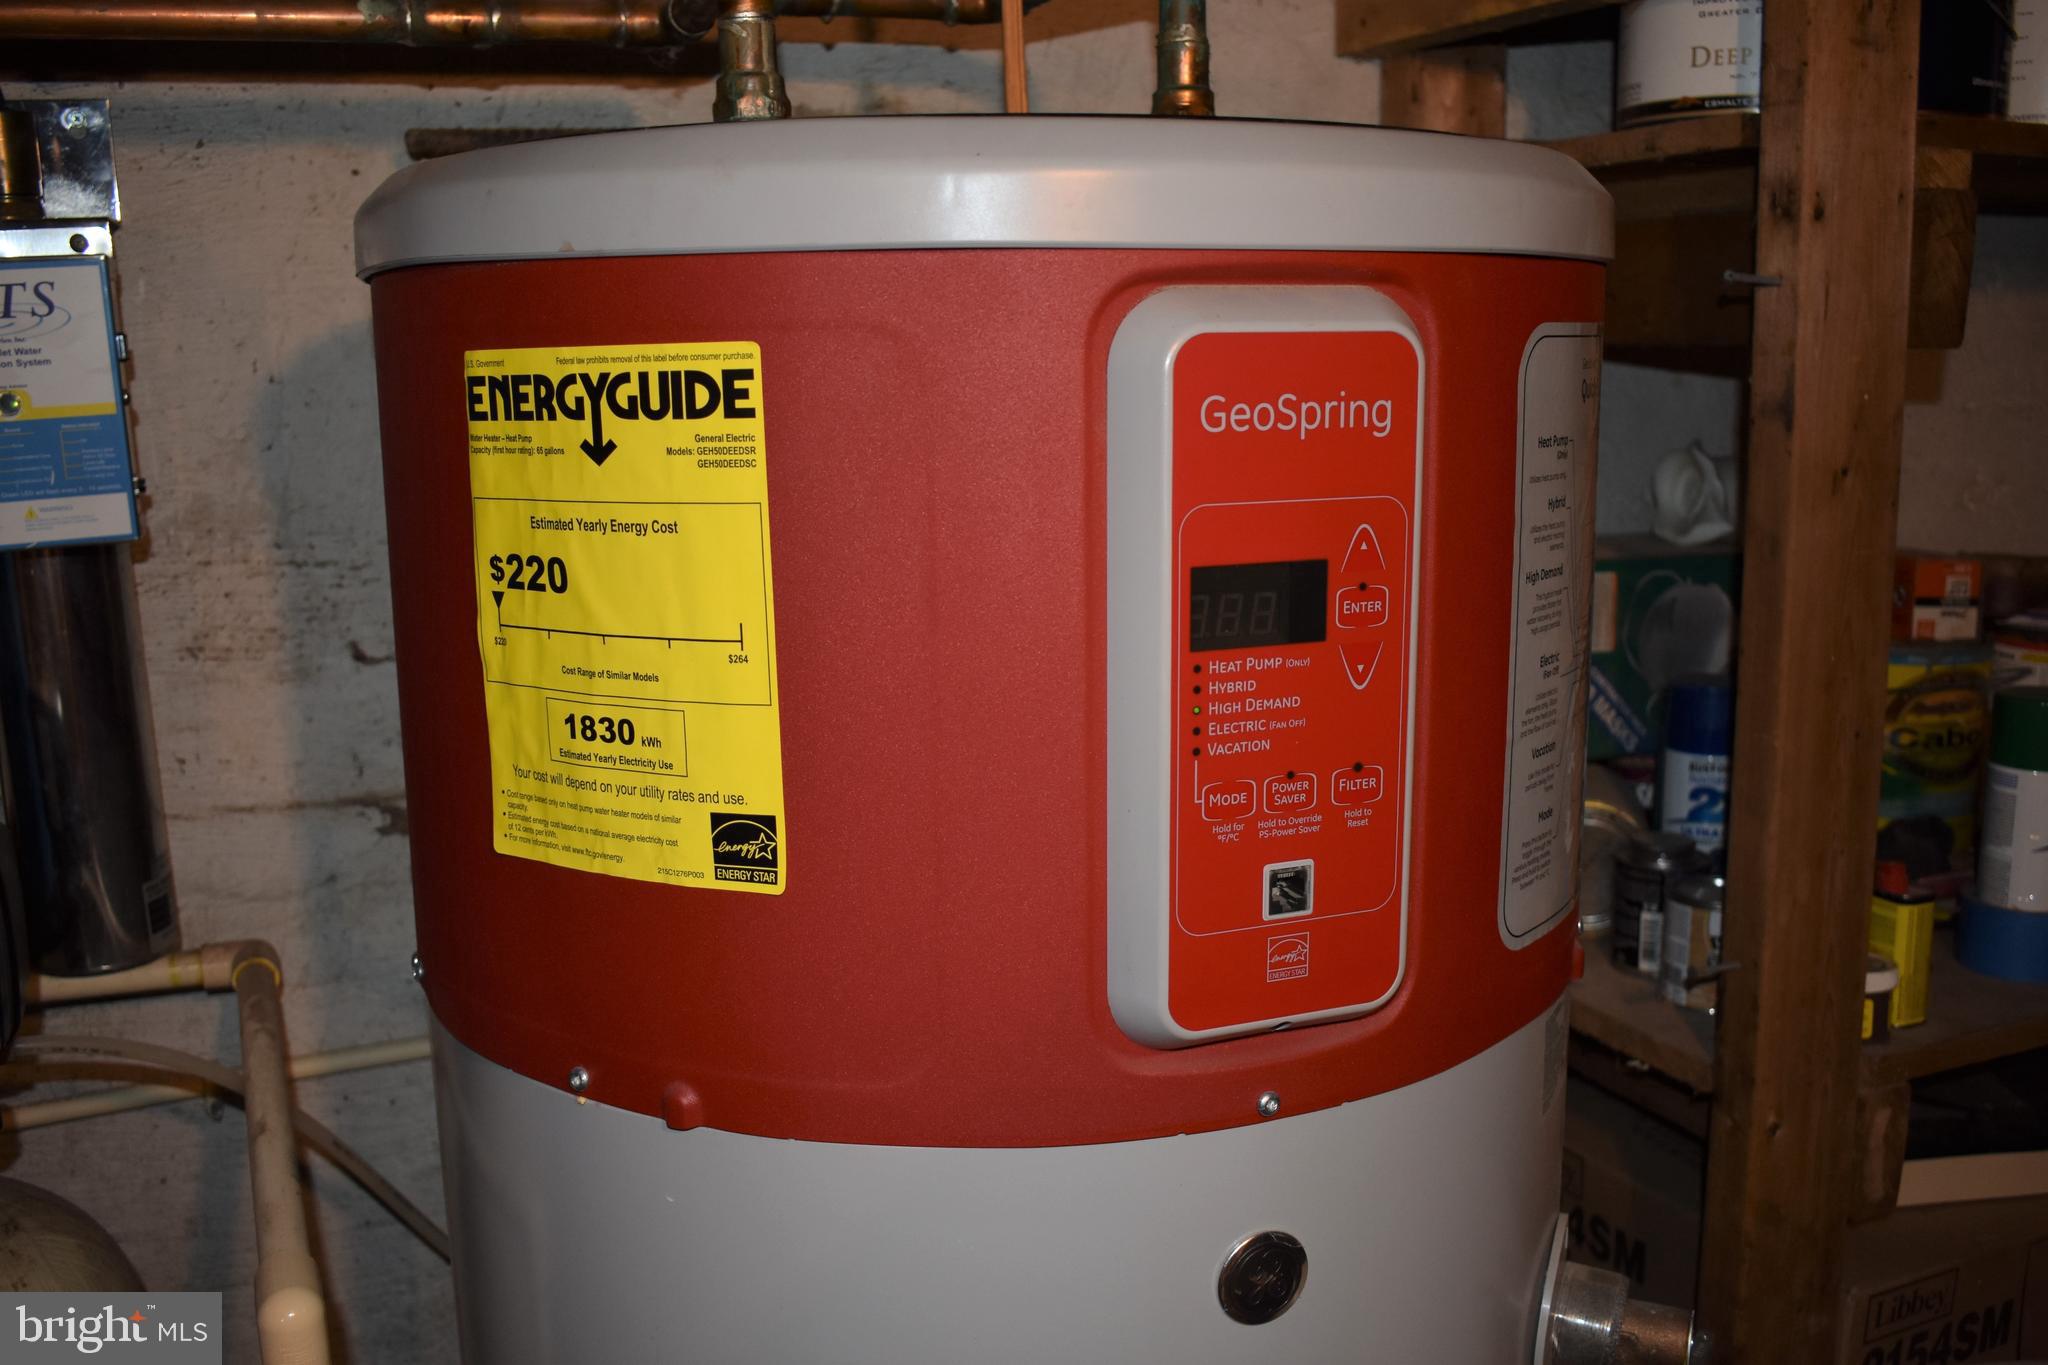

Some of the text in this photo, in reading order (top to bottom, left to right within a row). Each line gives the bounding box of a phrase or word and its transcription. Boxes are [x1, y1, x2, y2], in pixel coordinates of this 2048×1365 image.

[1690, 46, 1753, 68] DEEP
[15, 348, 42, 356] Water
[556, 357, 575, 366] Federal
[575, 357, 585, 366] law
[586, 356, 609, 368] prohibits
[610, 354, 633, 364] removal
[634, 353, 640, 363] of
[641, 353, 652, 363] this
[653, 353, 667, 362] label
[669, 352, 688, 362] before
[690, 353, 722, 361] consumer
[16, 359, 52, 370] System
[476, 359, 505, 370] Government
[467, 369, 757, 421] ENERGYGUIDE
[1200, 390, 1393, 440] GeoSpring
[484, 434, 501, 442] Heater
[505, 434, 517, 442] Heat
[518, 434, 533, 443] Pump
[695, 432, 756, 443] General Electric
[1537, 434, 1569, 449] Heat Pump
[471, 446, 491, 455] Capacity
[505, 446, 517, 455] hour
[544, 448, 565, 457] gallons
[666, 446, 756, 456] Models: GEH50DEEDSR
[697, 458, 757, 469] GEH50DEEDSC
[1547, 496, 1567, 512] Hybrid
[530, 516, 679, 537] Estimated Yearly Energy Cost
[489, 553, 568, 594] $220
[1525, 564, 1564, 584] High Demand
[1343, 600, 1382, 615] ENTER
[728, 653, 749, 665] $264
[1539, 651, 1560, 669] Electric
[561, 665, 659, 683] Cost Range of Similar Models
[564, 713, 662, 749] 1830 kWh
[559, 747, 674, 770] Estimated Yearly Electricity Use
[1531, 741, 1556, 760] Vacation
[512, 764, 748, 806] Your cost will depend on your utility rates and use.
[1271, 780, 1310, 794] POWER
[507, 788, 518, 799] Cost
[518, 791, 533, 802] range
[559, 800, 567, 808] on
[567, 800, 579, 811] heat
[579, 803, 593, 814] pump
[594, 806, 610, 816] water
[610, 807, 630, 818] heater
[630, 810, 653, 821] models
[653, 813, 661, 822] of
[661, 814, 682, 825] similar
[1274, 793, 1307, 806] SAVER
[1343, 807, 1373, 819] Hold to
[1537, 808, 1553, 824] Mode
[508, 811, 531, 823] Estimated
[532, 815, 549, 828] energy
[549, 818, 561, 829] cost
[561, 821, 577, 832] based
[577, 825, 584, 833] on
[589, 827, 610, 838] national
[611, 831, 635, 843] average
[636, 835, 665, 847] electricity
[508, 822, 514, 830] of
[514, 824, 522, 832] 12
[535, 828, 544, 838] per
[1212, 822, 1245, 834] Hold for
[1257, 814, 1323, 830] Hold to Override
[1347, 817, 1369, 829] Reset
[1258, 825, 1321, 840] PS-Power Saver
[509, 832, 518, 842] For
[518, 835, 532, 845] more
[561, 842, 571, 852] visit
[717, 869, 776, 884] ENERGY STAR
[1268, 966, 1307, 980] ENERGY STAR
[1875, 1287, 1944, 1328] Libbey
